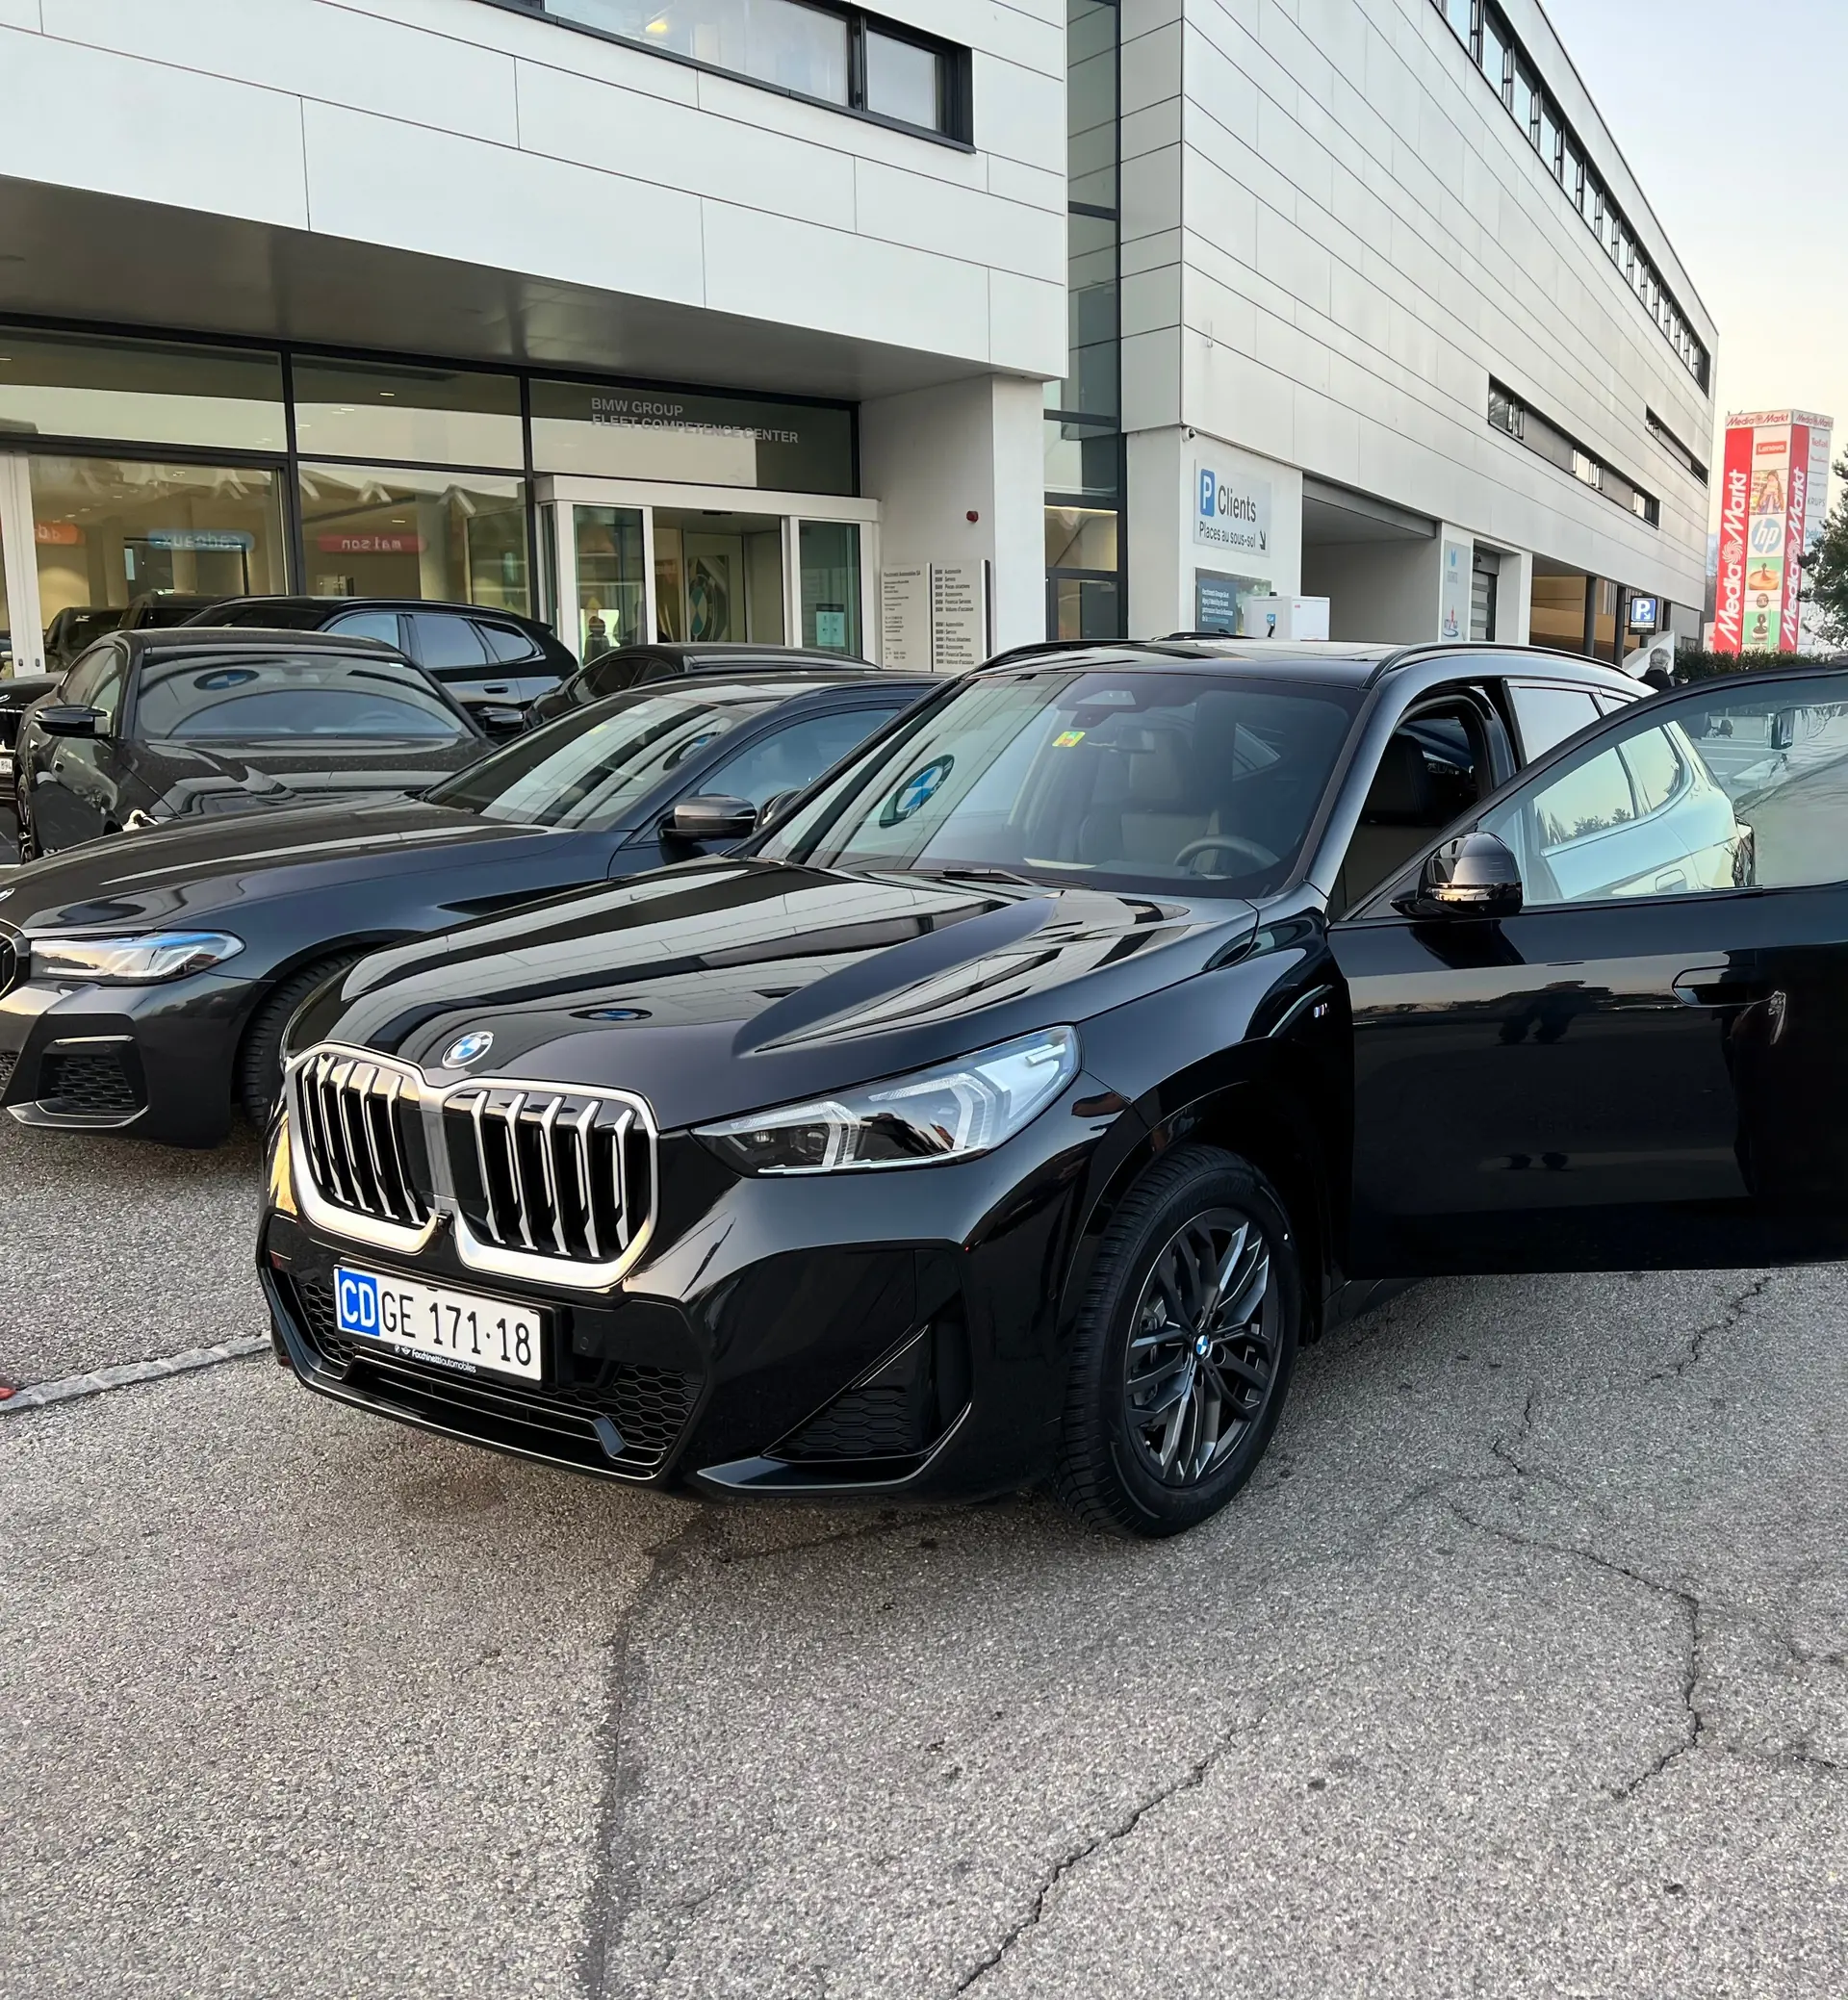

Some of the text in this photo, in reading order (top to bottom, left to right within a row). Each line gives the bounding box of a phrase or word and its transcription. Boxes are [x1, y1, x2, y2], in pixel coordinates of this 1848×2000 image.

[591, 397, 683, 417] BMW GROUP
[1727, 413, 1789, 426] Media Markt
[592, 413, 799, 444] FLEET COMPETENCE CENTER
[1758, 444, 1785, 453] Lenovo
[1810, 437, 1829, 449] Tefal
[1202, 474, 1257, 523] P Clients
[1807, 498, 1826, 507] KRUPS
[1199, 521, 1256, 549] Places au sous-sol
[1754, 518, 1781, 554] hp
[1717, 468, 1747, 646] Media Markt
[1783, 466, 1805, 646] Media Markt
[1635, 600, 1651, 620] P
[340, 1278, 377, 1328] CD
[381, 1290, 416, 1339] GE
